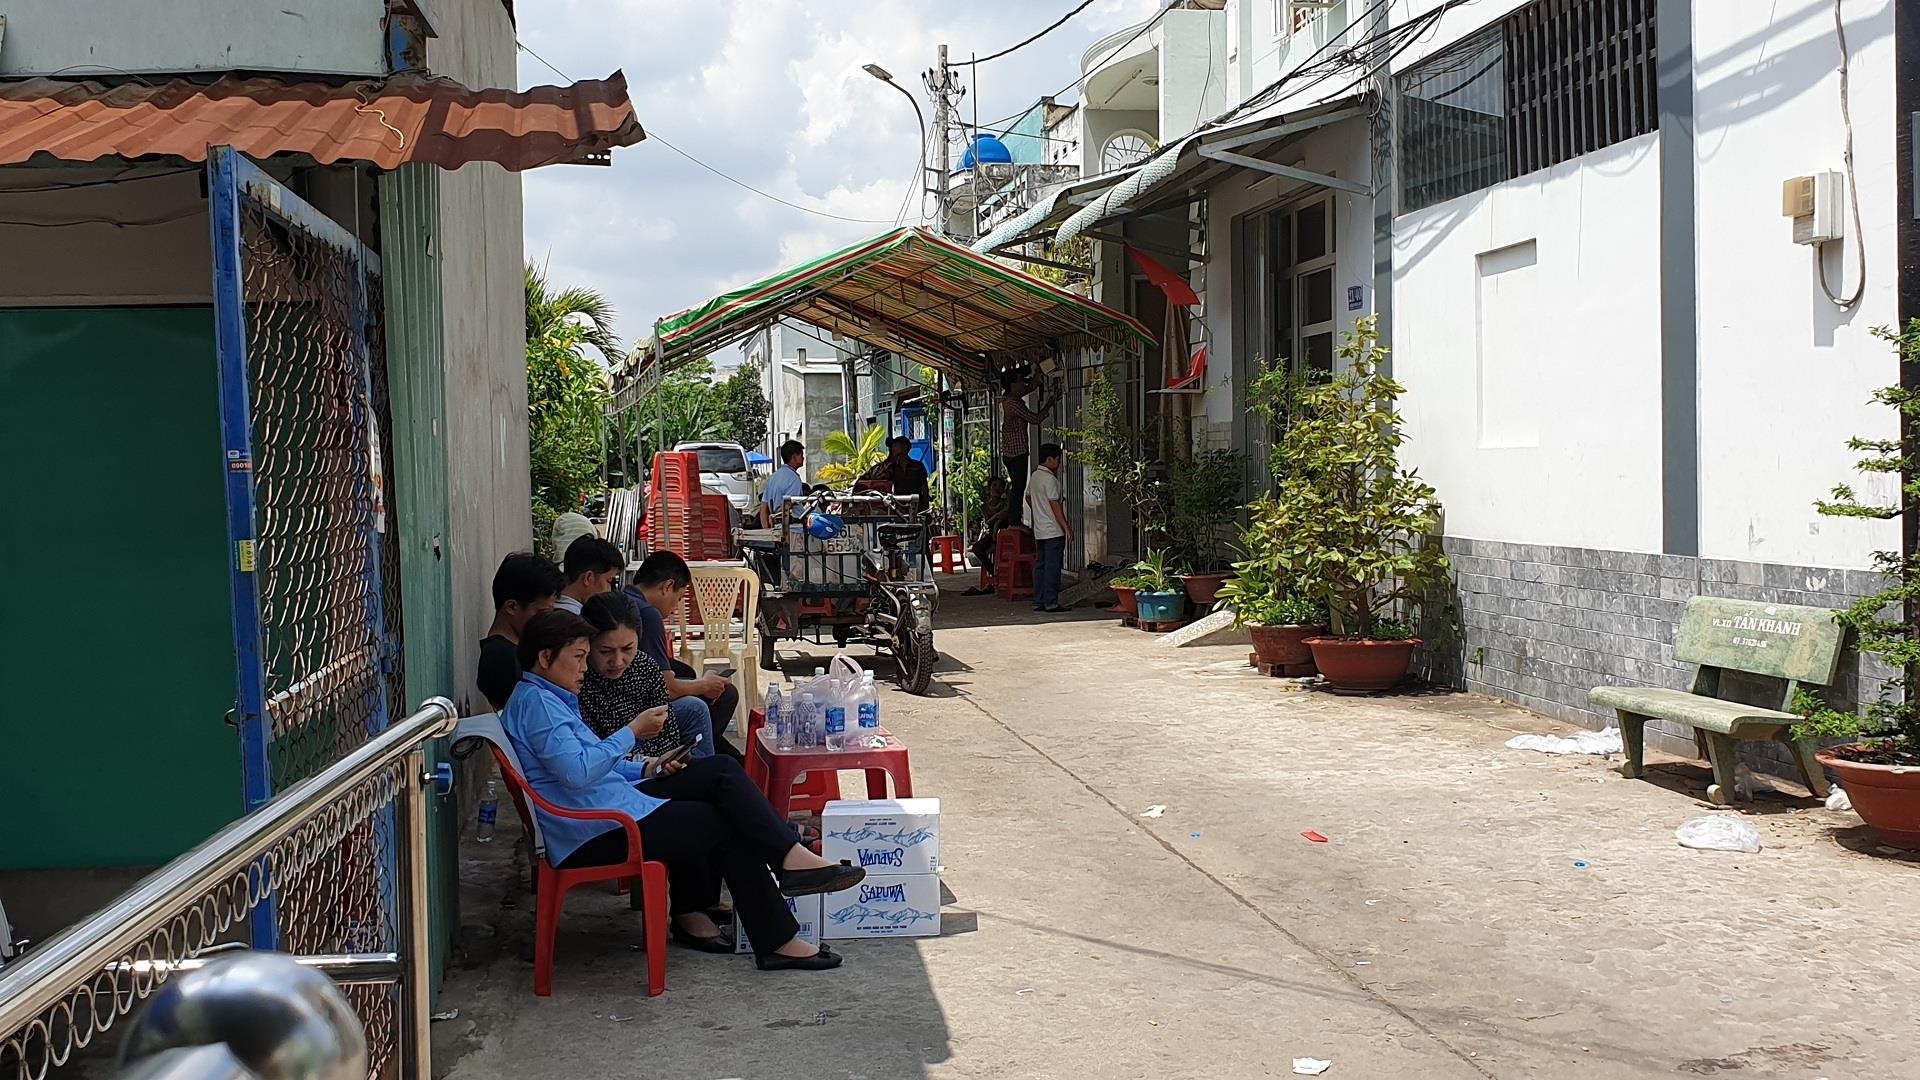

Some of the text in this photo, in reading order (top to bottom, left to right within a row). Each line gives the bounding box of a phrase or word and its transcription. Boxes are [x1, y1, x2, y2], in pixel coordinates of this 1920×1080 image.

[1757, 618, 1802, 636] KHANH
[857, 847, 904, 867] SAPUWA
[859, 883, 906, 904] SAPUWA
